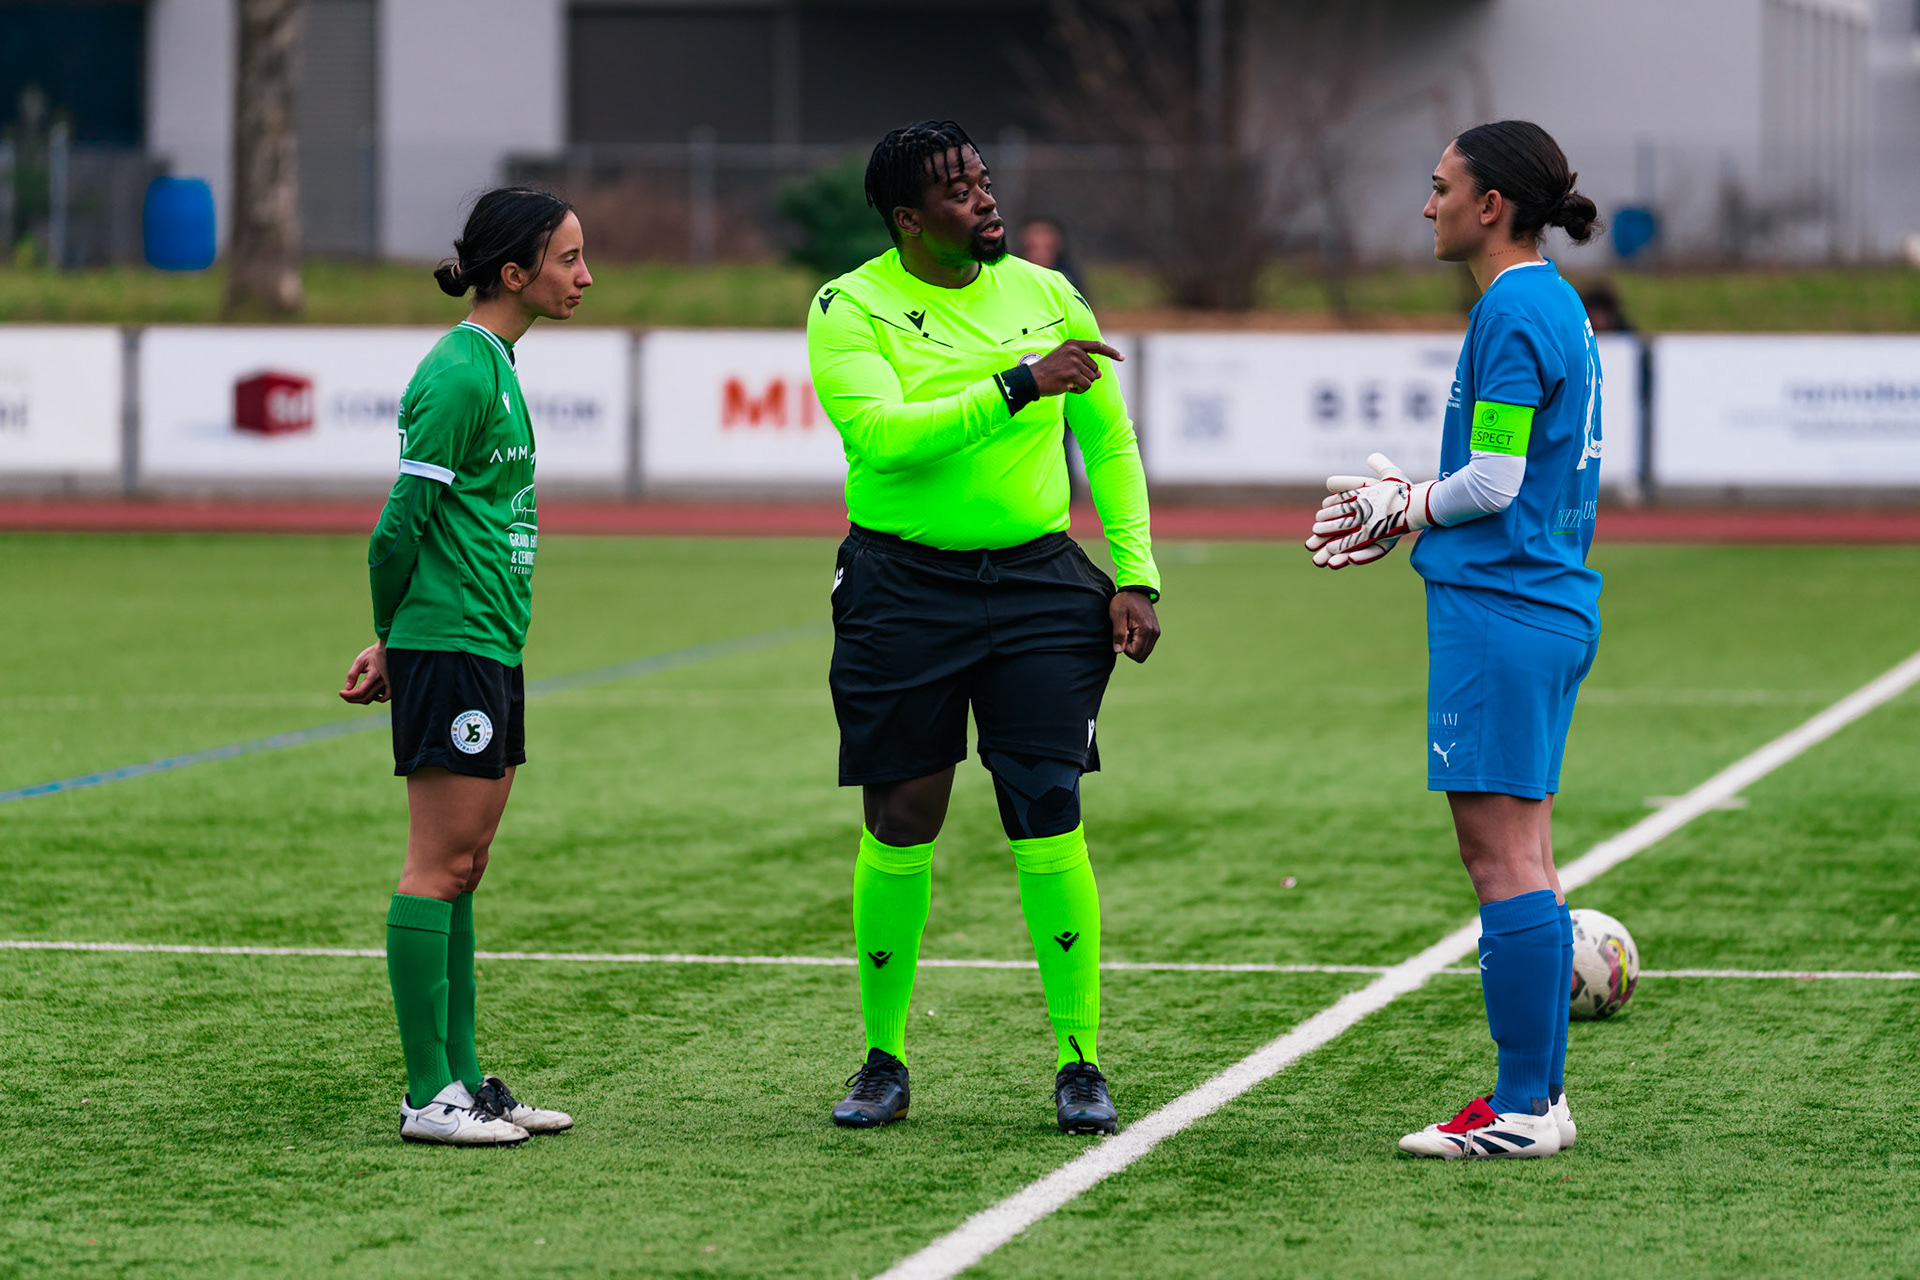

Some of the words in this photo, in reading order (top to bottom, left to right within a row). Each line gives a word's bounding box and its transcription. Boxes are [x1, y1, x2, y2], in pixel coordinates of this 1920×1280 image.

[1472, 430, 1514, 446] ESPECT
[509, 532, 529, 549] GRAND
[511, 551, 518, 565] &
